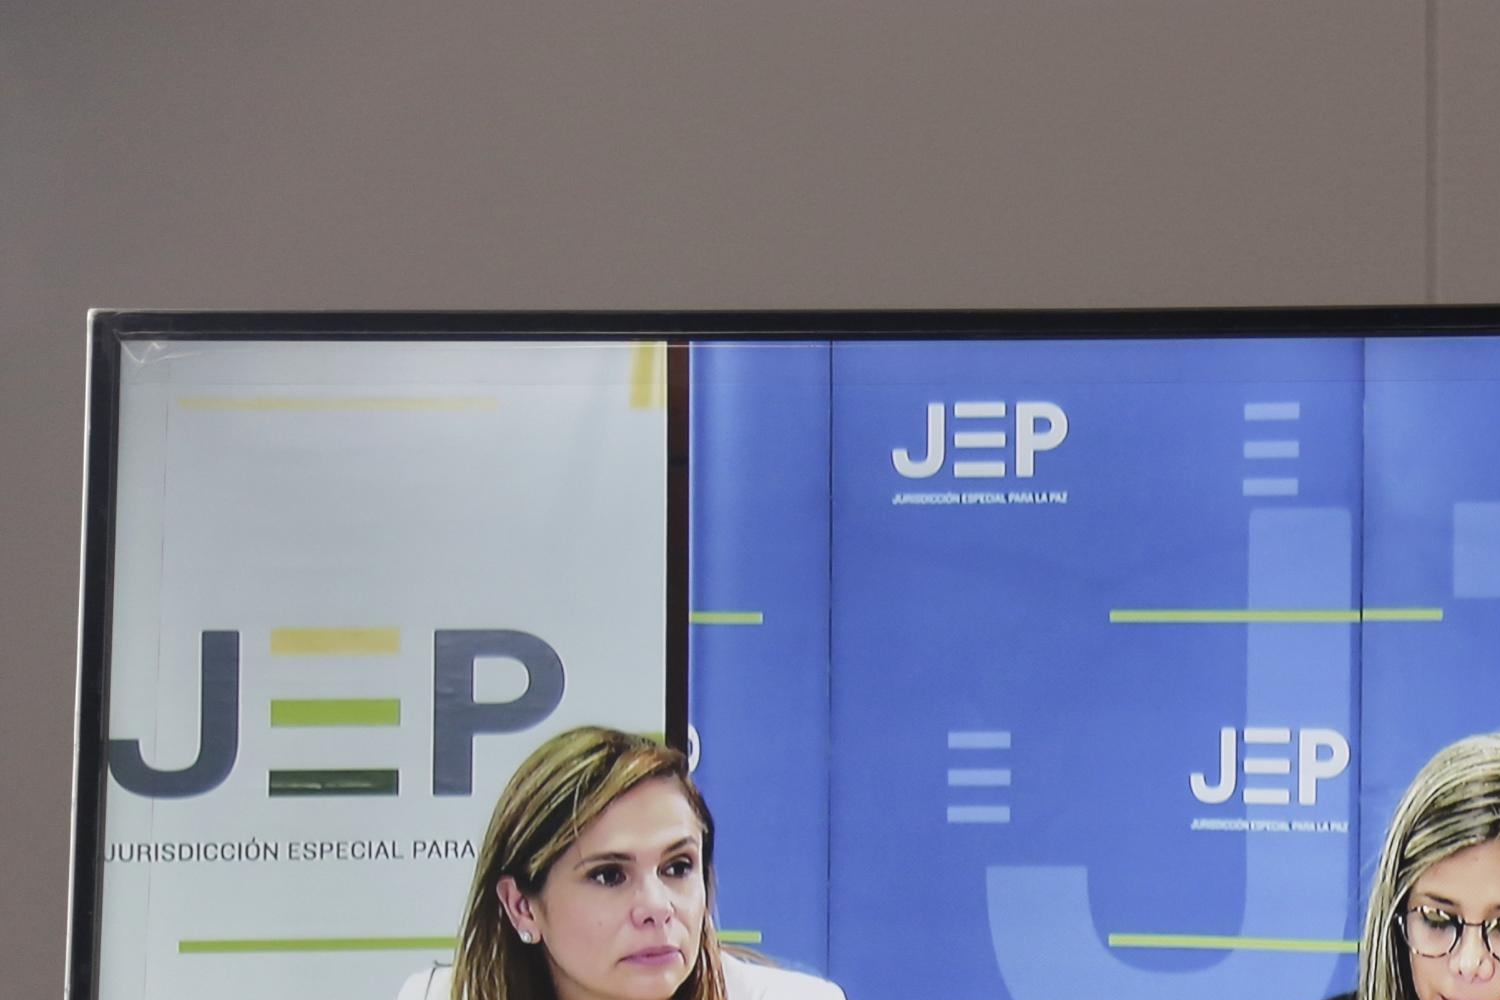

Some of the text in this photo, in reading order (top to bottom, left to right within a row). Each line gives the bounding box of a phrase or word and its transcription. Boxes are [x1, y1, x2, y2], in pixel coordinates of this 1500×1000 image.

[891, 401, 1069, 478] JEP
[1035, 491, 1049, 503] LA
[107, 628, 566, 799] JEP
[1190, 727, 1350, 805] JEP
[104, 837, 476, 863] JURISDICCIÓN ESPECIAL PARA
